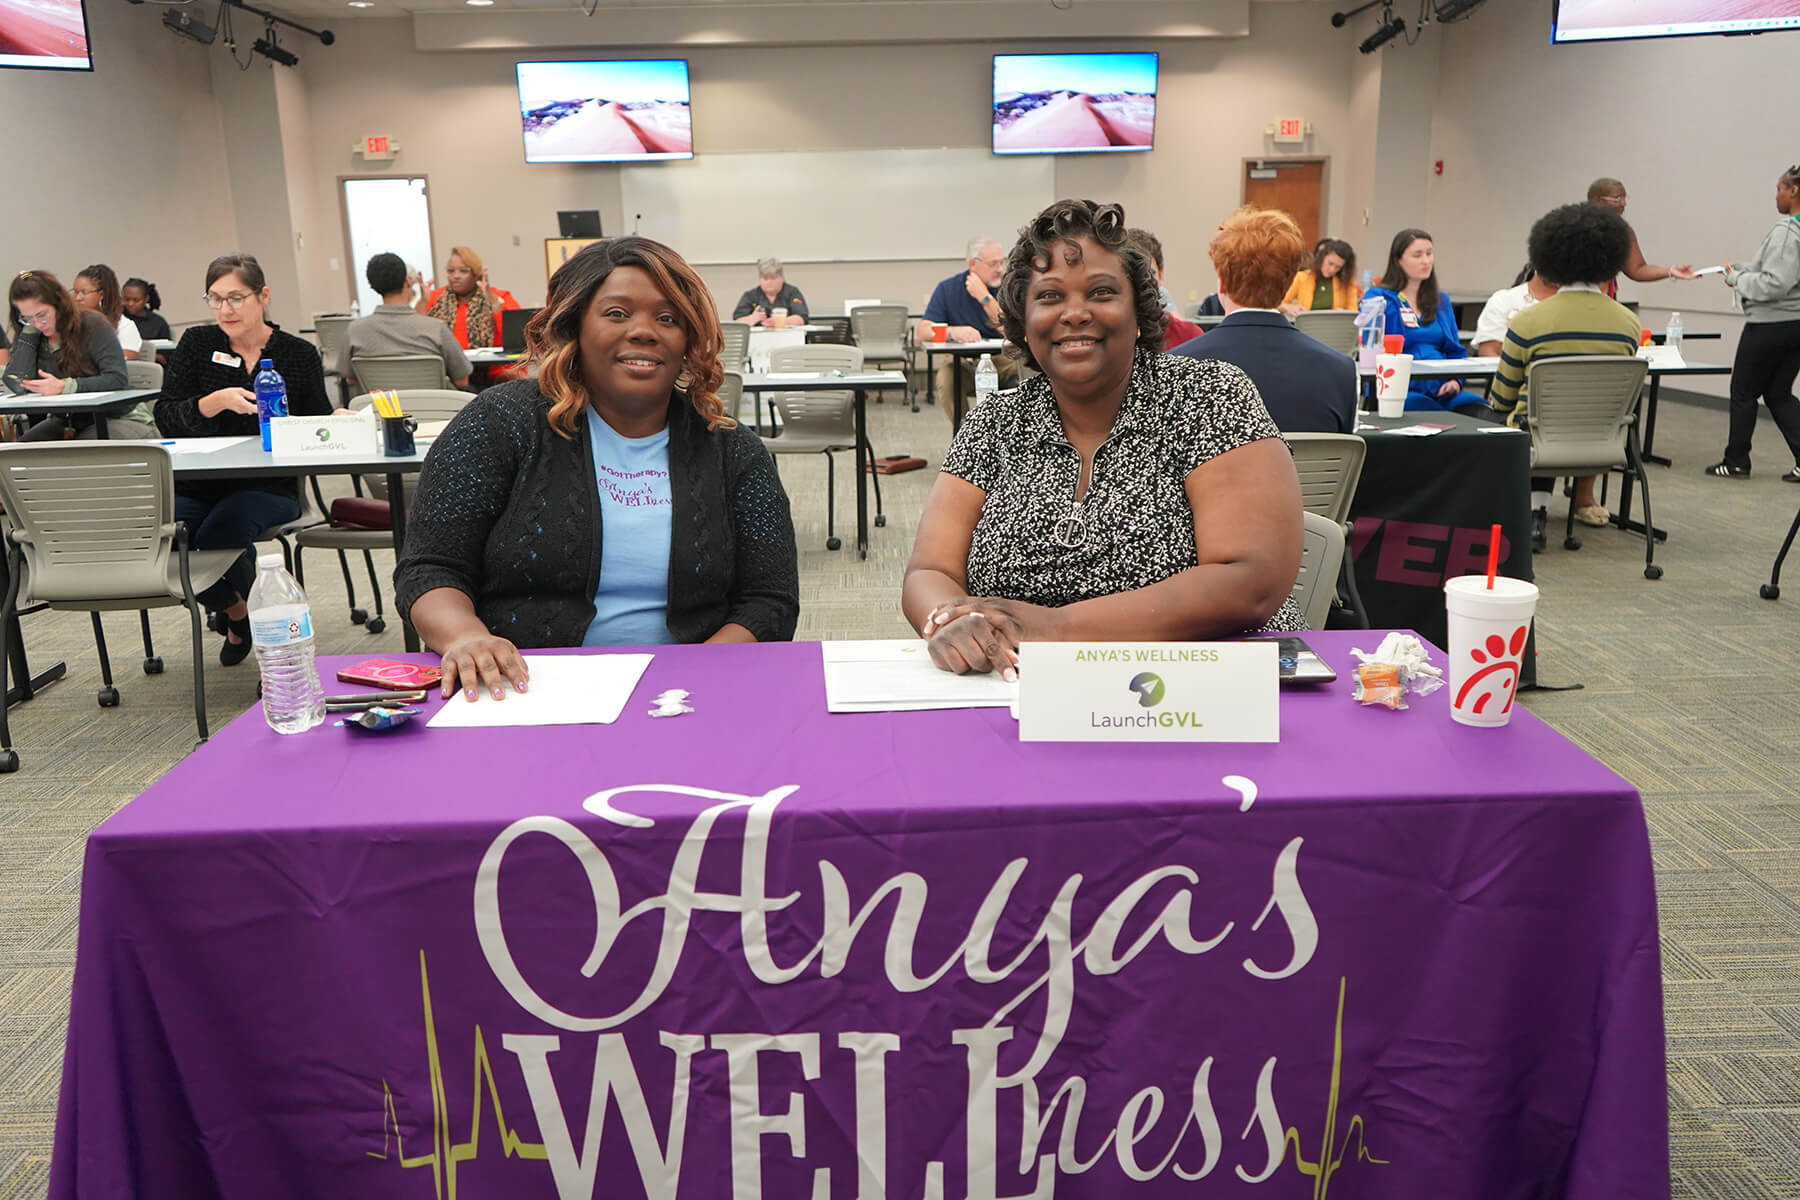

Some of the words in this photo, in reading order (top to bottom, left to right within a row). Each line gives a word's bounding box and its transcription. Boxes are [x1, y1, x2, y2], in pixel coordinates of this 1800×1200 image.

[1280, 119, 1300, 136] EXIT
[367, 137, 388, 152] EXIT
[600, 464, 668, 479] #GotTherapy?
[1076, 649, 1131, 662] ANYA'S
[1135, 649, 1219, 662] WELLNESS
[1091, 711, 1203, 728] LaunchGVL
[474, 775, 1320, 1088] Anya's
